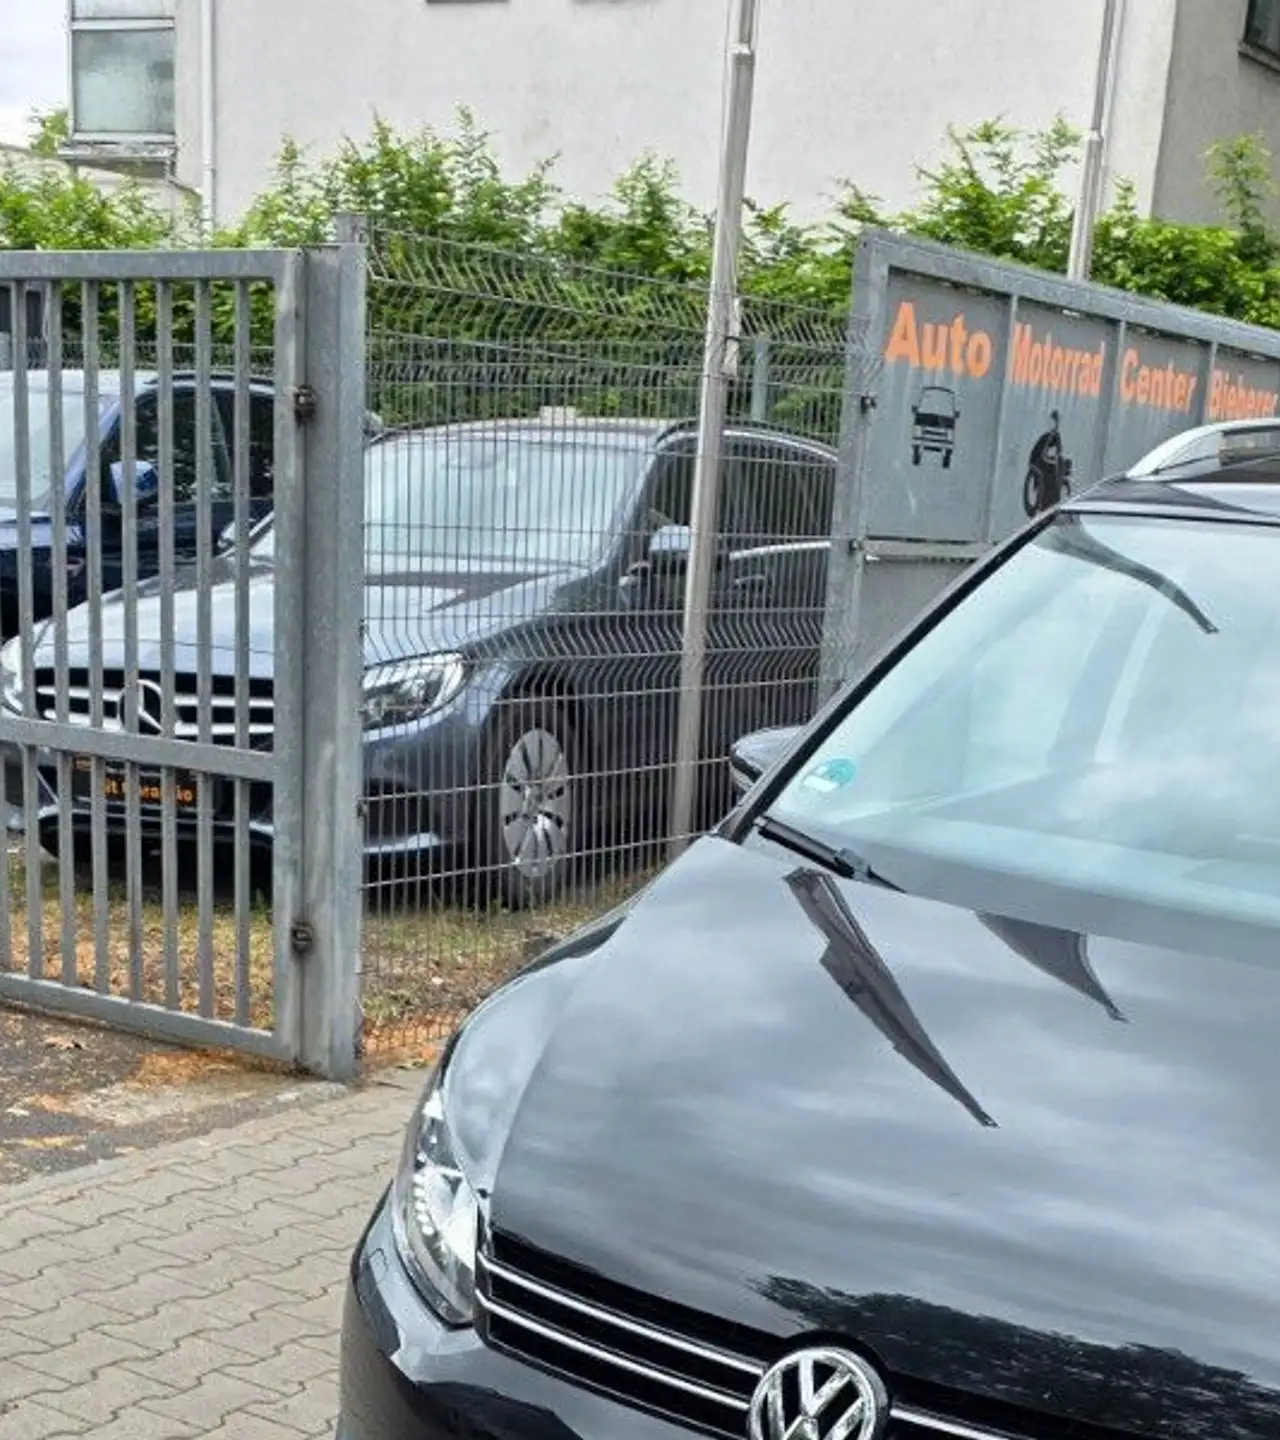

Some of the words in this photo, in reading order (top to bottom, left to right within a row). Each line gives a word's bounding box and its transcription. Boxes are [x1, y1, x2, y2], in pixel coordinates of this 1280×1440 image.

[885, 300, 992, 378] Auto
[1009, 320, 1105, 398] Motorrad
[1122, 347, 1197, 414] Center
